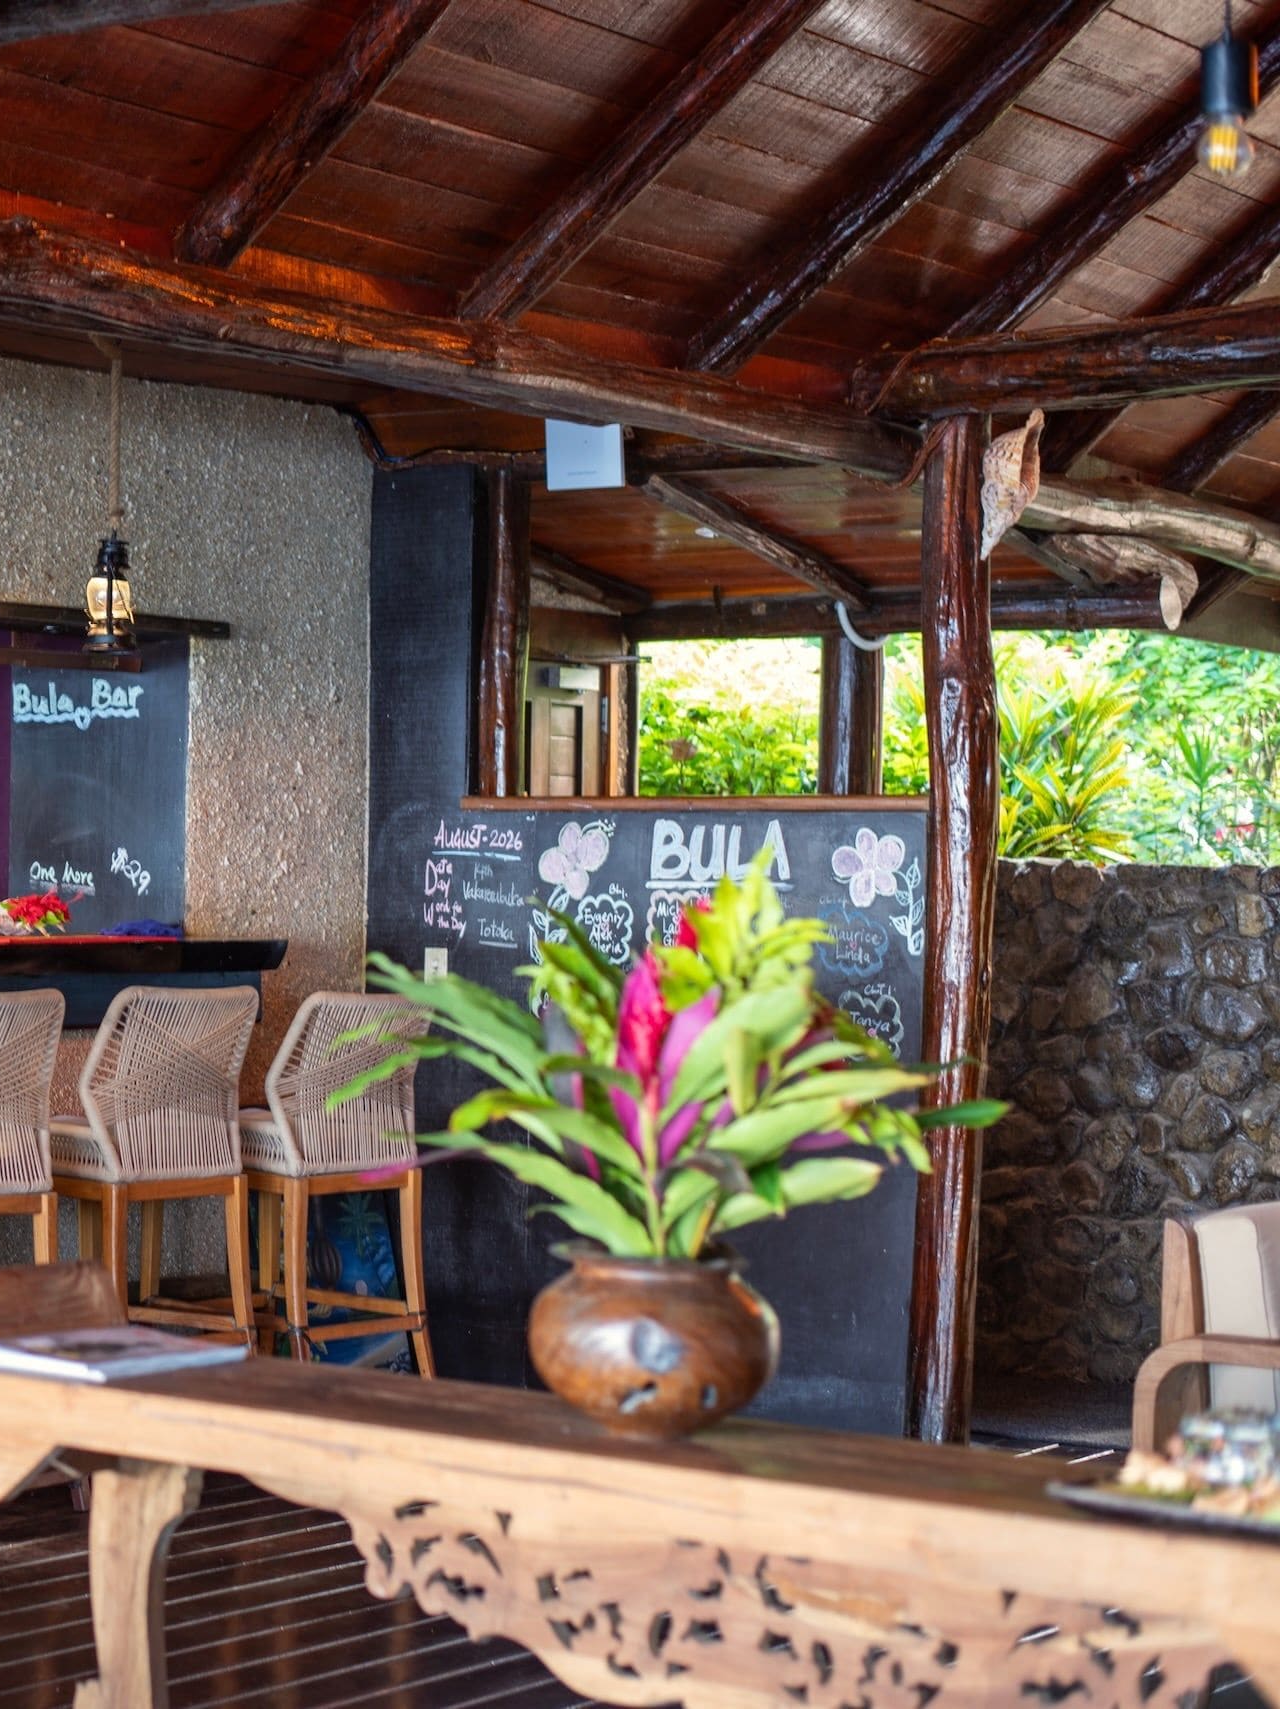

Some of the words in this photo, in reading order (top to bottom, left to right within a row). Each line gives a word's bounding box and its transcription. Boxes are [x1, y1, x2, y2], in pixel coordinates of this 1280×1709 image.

[12, 681, 74, 716] Bula
[91, 677, 144, 710] Bar
[650, 818, 791, 882] BULA
[30, 861, 58, 883] One
[62, 861, 94, 887] More
[835, 944, 871, 964] Linda
[850, 1011, 891, 1033] Tanya
